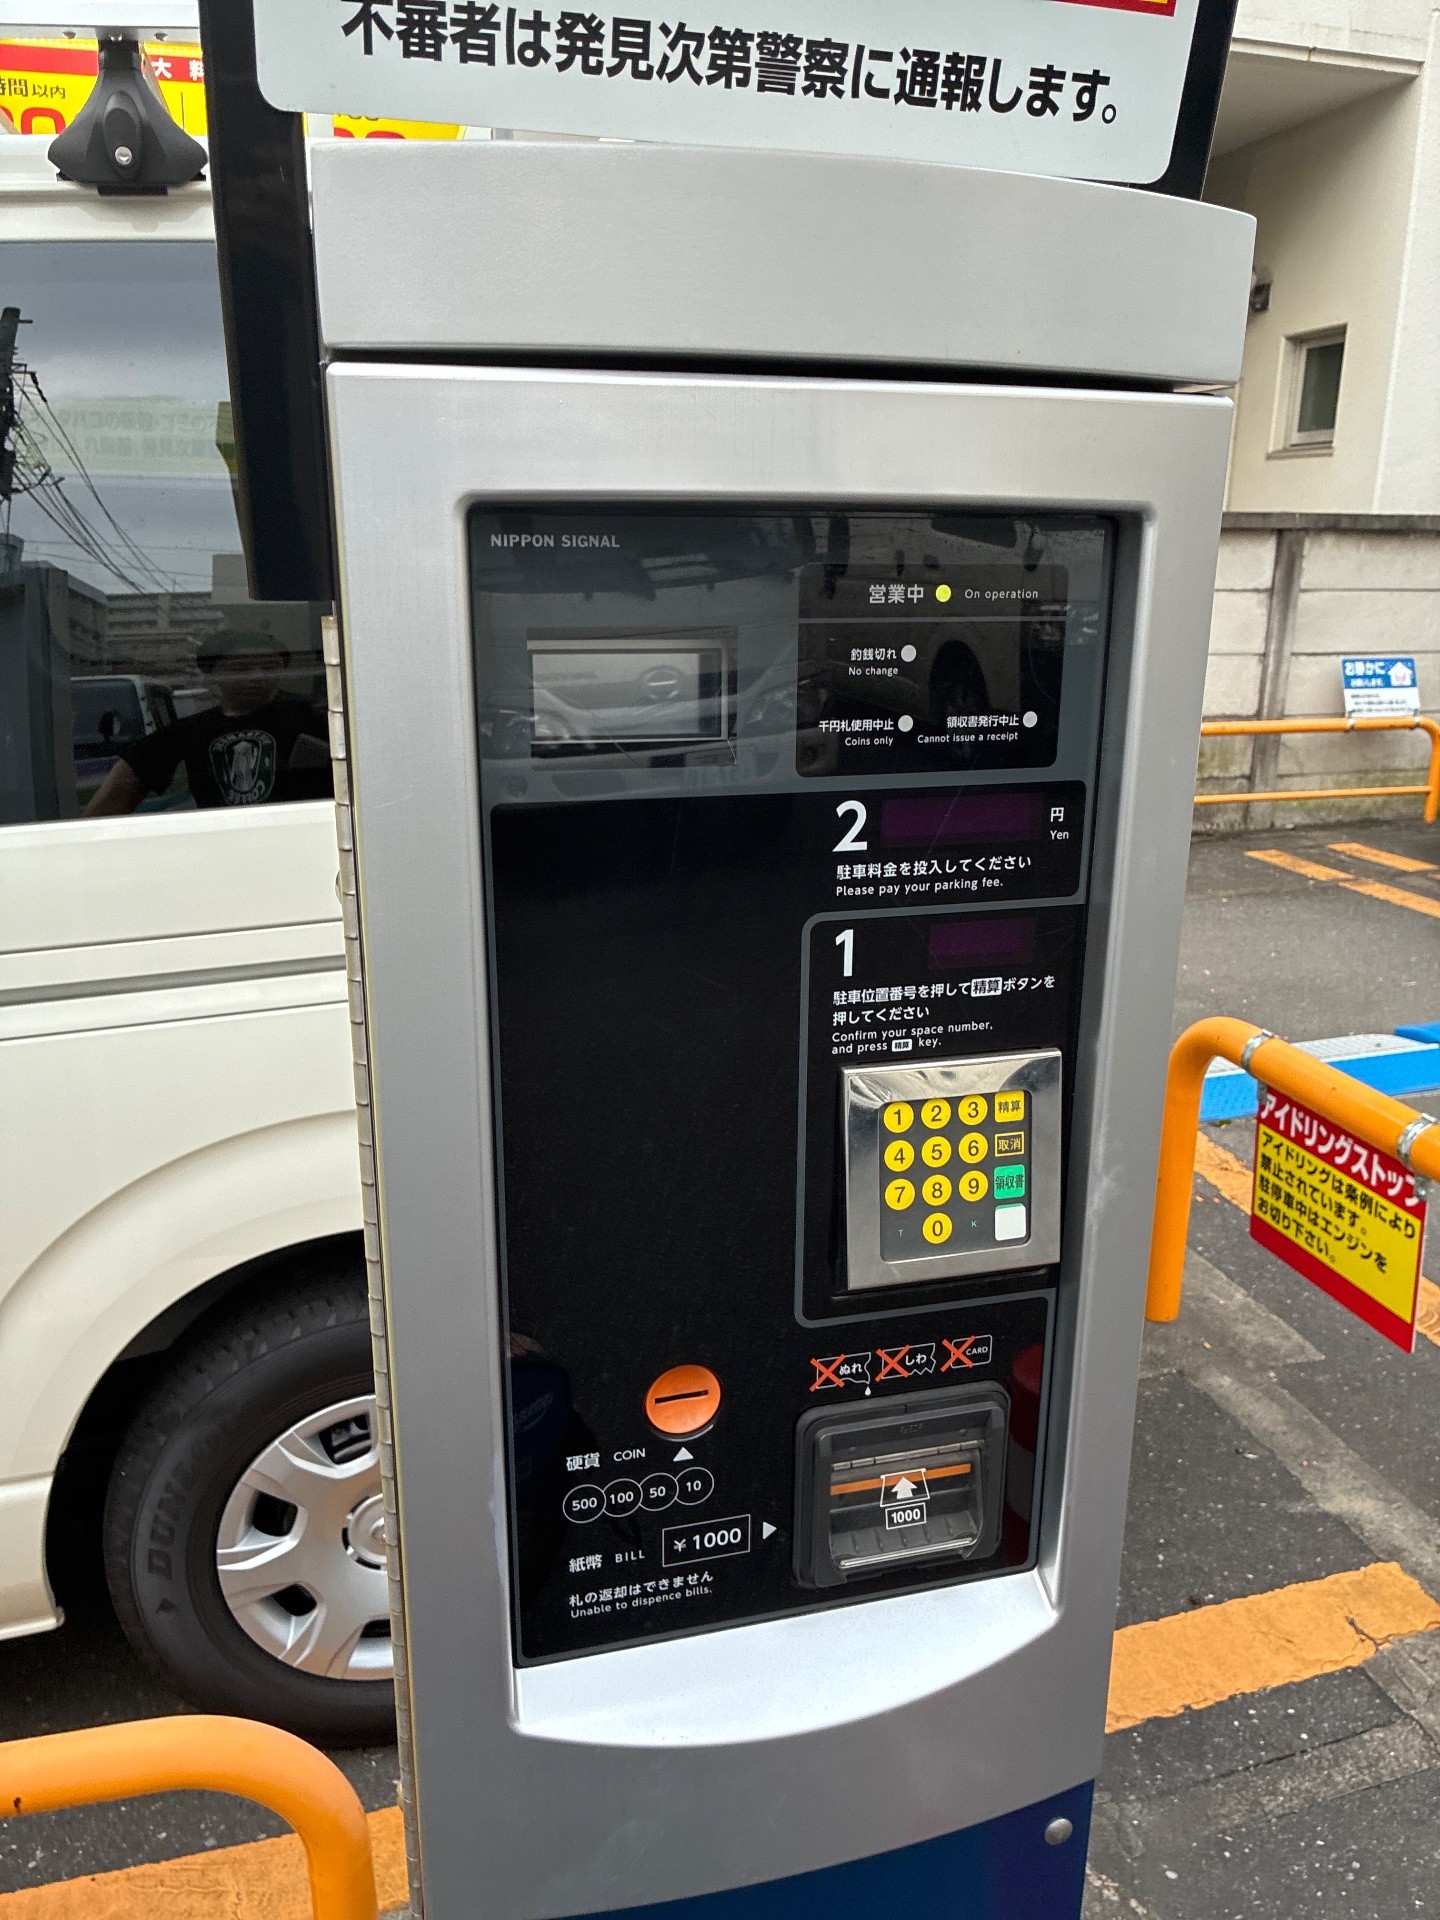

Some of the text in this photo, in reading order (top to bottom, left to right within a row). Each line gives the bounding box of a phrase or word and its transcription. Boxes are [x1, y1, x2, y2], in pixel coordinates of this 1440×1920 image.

[341, 0, 1117, 124] 不審者は発見次第警察に通報します。
[490, 534, 620, 548] NIPPON SIGNAL
[869, 584, 924, 604] 営業中
[964, 589, 1038, 601] On operation
[851, 648, 897, 661] 釣銭切れ
[848, 666, 898, 677] No change
[818, 719, 894, 733] 千円札使用中止
[947, 715, 1019, 728] 領収書発行中止
[845, 736, 893, 747] Coins only
[917, 734, 950, 744] Cannot
[952, 733, 975, 743] issue
[987, 731, 1019, 742] receipt
[1050, 806, 1064, 822] 円
[832, 800, 867, 852] 2
[1050, 830, 1069, 840] Yen
[836, 855, 1032, 881] 駐車料金を投入してください
[836, 877, 1003, 896] Please pay your parking fee.
[835, 929, 854, 977] 1
[832, 1007, 930, 1027] 押してください
[832, 1029, 877, 1043] Confirm
[881, 1028, 907, 1040] your
[911, 1025, 944, 1038] space
[831, 1044, 853, 1055] and
[857, 1042, 888, 1056] press
[918, 1037, 942, 1049] key.
[931, 1105, 942, 1122] 2
[967, 1101, 979, 1118] 3
[997, 1099, 1021, 1113] 精算
[893, 1109, 902, 1125] 1
[931, 1144, 943, 1160] 5
[968, 1140, 979, 1156] 6
[998, 1138, 1021, 1151] 取消
[893, 1148, 905, 1164] 4
[968, 1178, 979, 1194] 9
[995, 1174, 1023, 1190] 領収書
[1262, 1131, 1416, 1240] アイドリングは条例により
[894, 1187, 906, 1203] 7
[932, 1182, 943, 1199] 8
[1260, 1153, 1367, 1235] 禁止されています。
[932, 1221, 943, 1237] 0
[1257, 1196, 1336, 1263] お切り下さい。
[1259, 1174, 1387, 1274] 駐停車中はエンジンを
[905, 1352, 927, 1366] しわ
[965, 1346, 988, 1356] CARD
[839, 1363, 863, 1375] ぬれ
[566, 1448, 646, 1471] 硬貨 COIN
[572, 1481, 702, 1511] 500 100 50 10
[891, 1508, 921, 1524] 1000
[569, 1550, 646, 1573] 紙幣 BILL
[569, 1571, 714, 1607] 札の返却はできません
[570, 1604, 612, 1618] Unable
[615, 1602, 627, 1611] to
[685, 1584, 713, 1596] bills.
